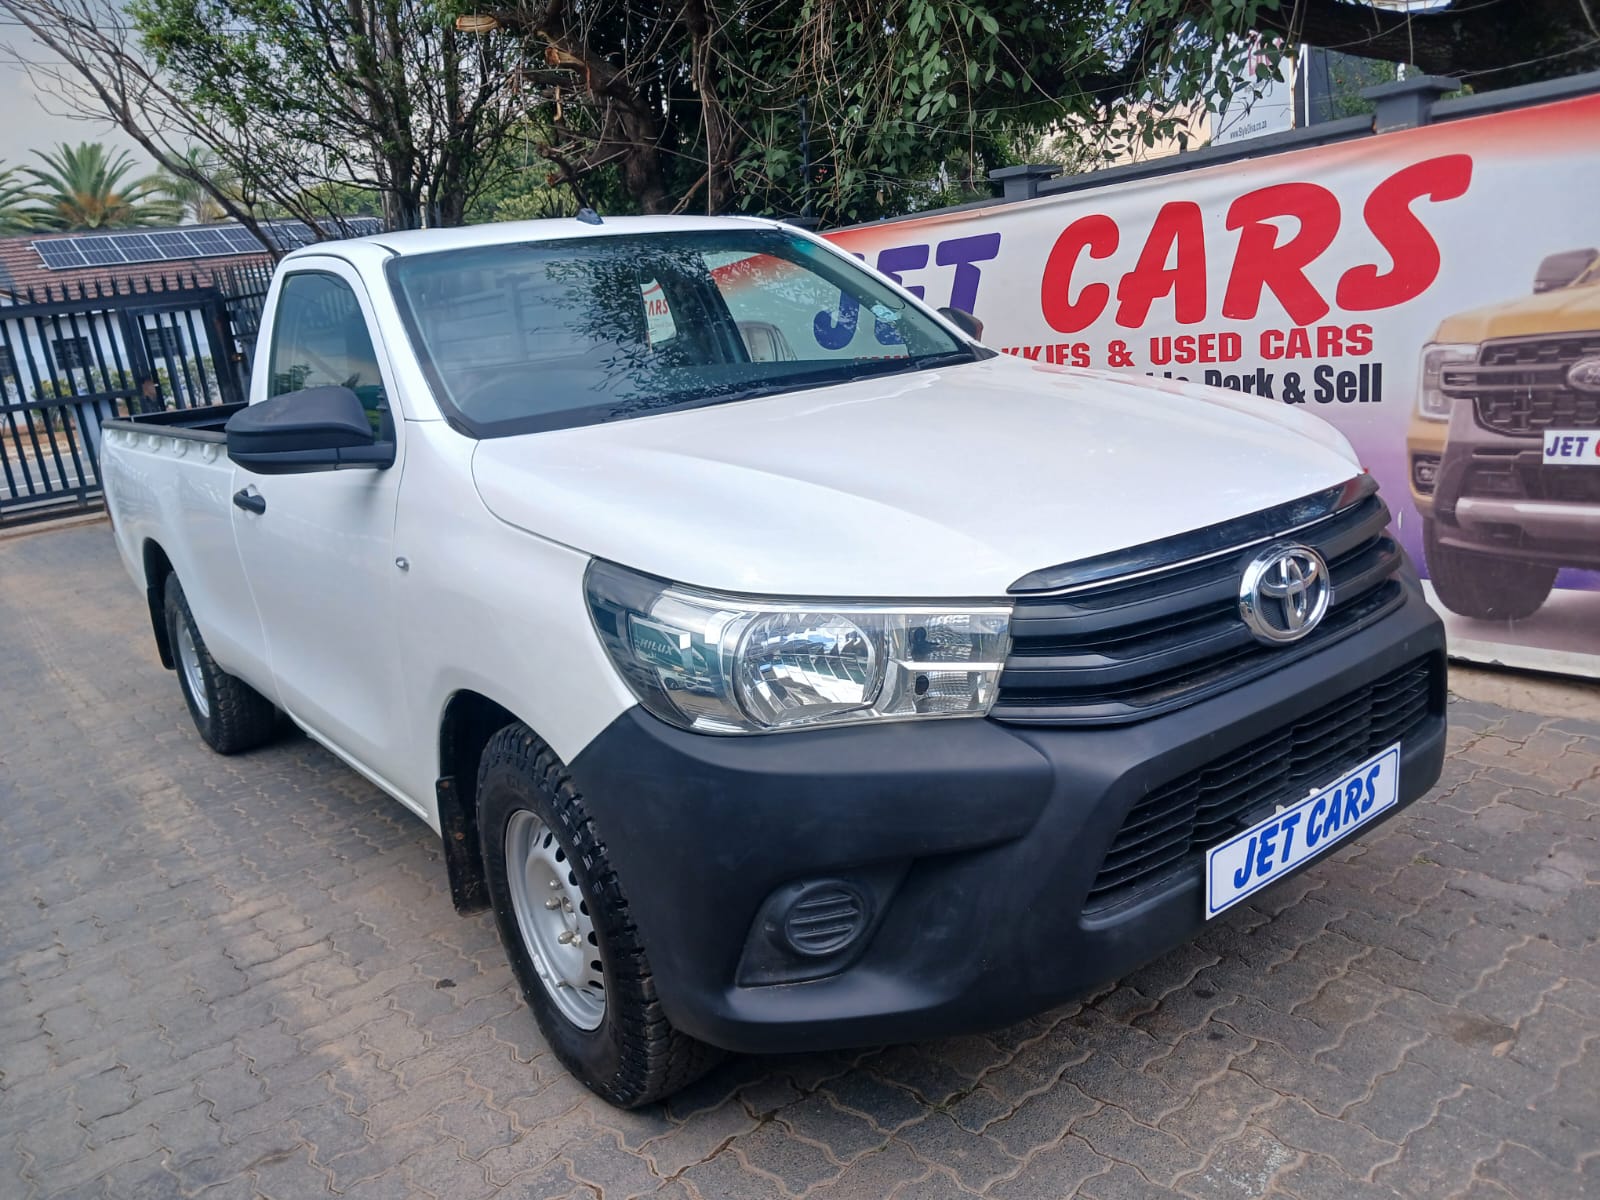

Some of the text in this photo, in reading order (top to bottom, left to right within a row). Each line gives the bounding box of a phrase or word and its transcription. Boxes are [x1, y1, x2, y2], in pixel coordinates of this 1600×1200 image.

[1041, 153, 1473, 334] CARS
[643, 299, 669, 316] ARS
[1107, 339, 1136, 368] &
[1149, 332, 1242, 365] USED
[1259, 323, 1374, 361] CARS
[1282, 371, 1306, 404] &
[1313, 363, 1383, 404] Sell
[1545, 436, 1589, 457] JET
[1233, 764, 1381, 889] JET CARS
